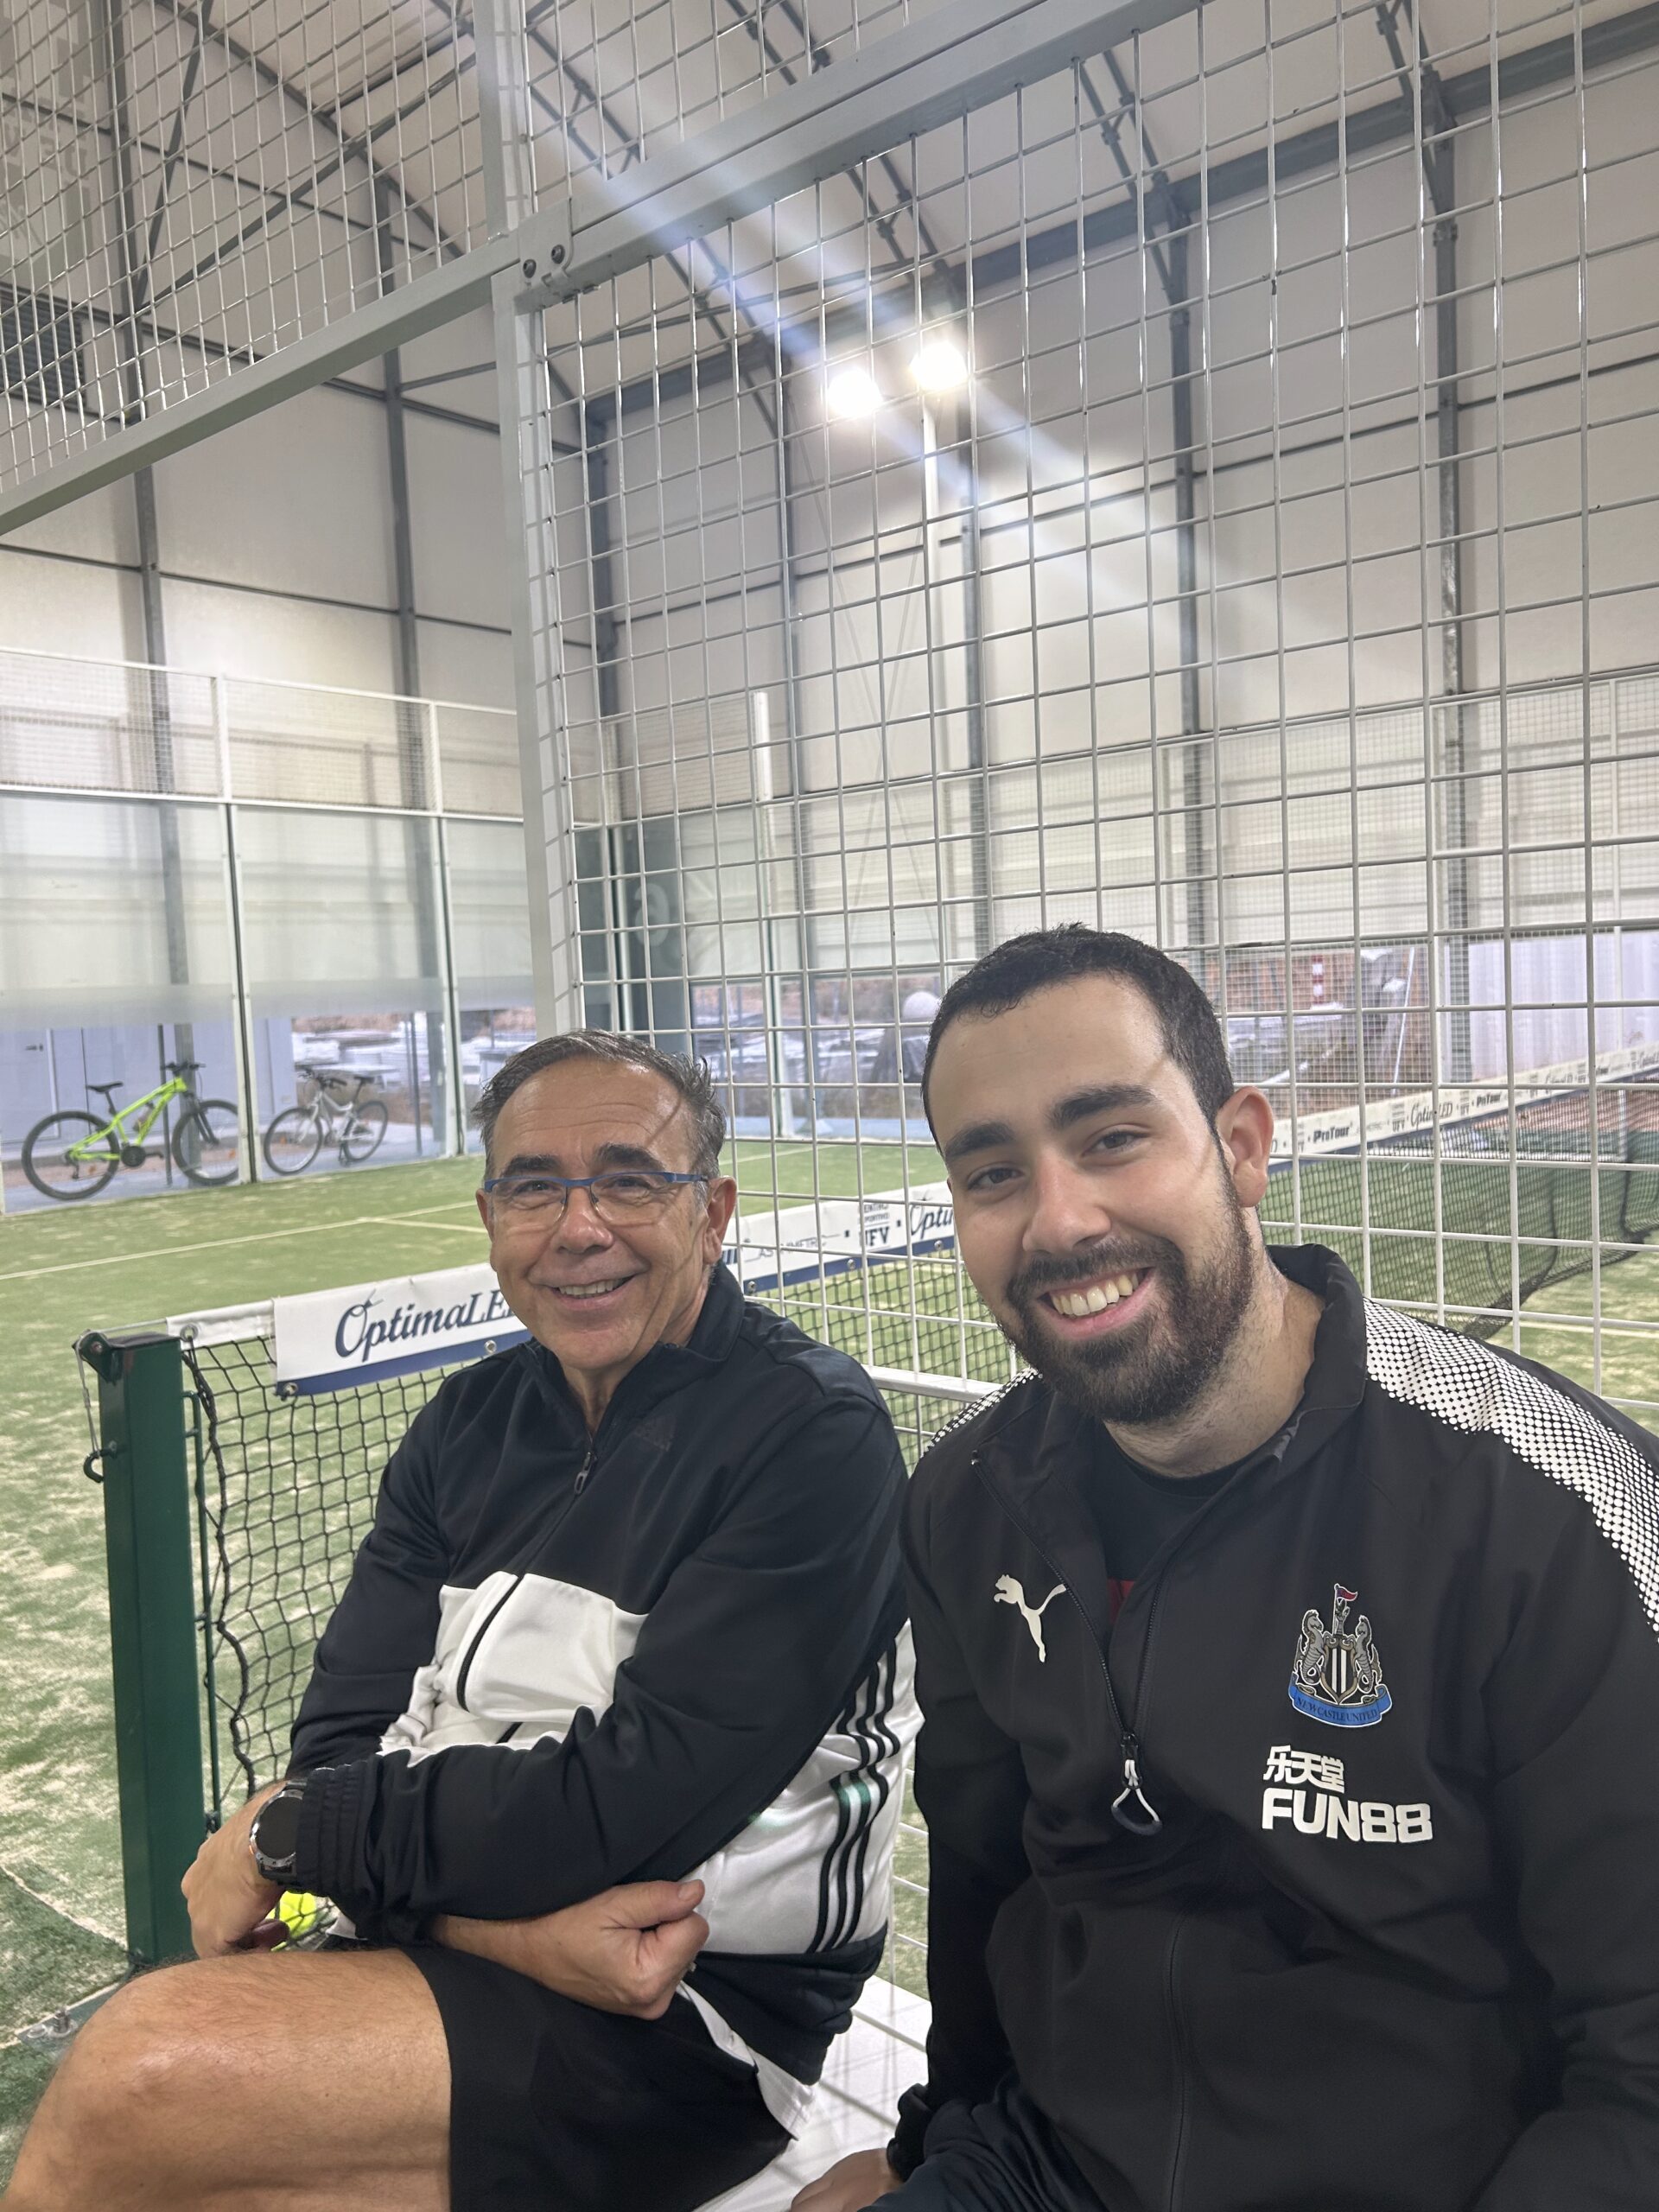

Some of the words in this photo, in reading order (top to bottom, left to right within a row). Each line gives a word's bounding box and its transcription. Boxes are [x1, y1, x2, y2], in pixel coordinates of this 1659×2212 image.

[335, 1289, 515, 1363] OptimaLE
[1297, 1697, 1345, 1720] NEWCASTLE
[1346, 1709, 1377, 1722] UNITED
[1262, 1745, 1345, 1794] 乐天堂
[1262, 1787, 1433, 1843] FUN88
